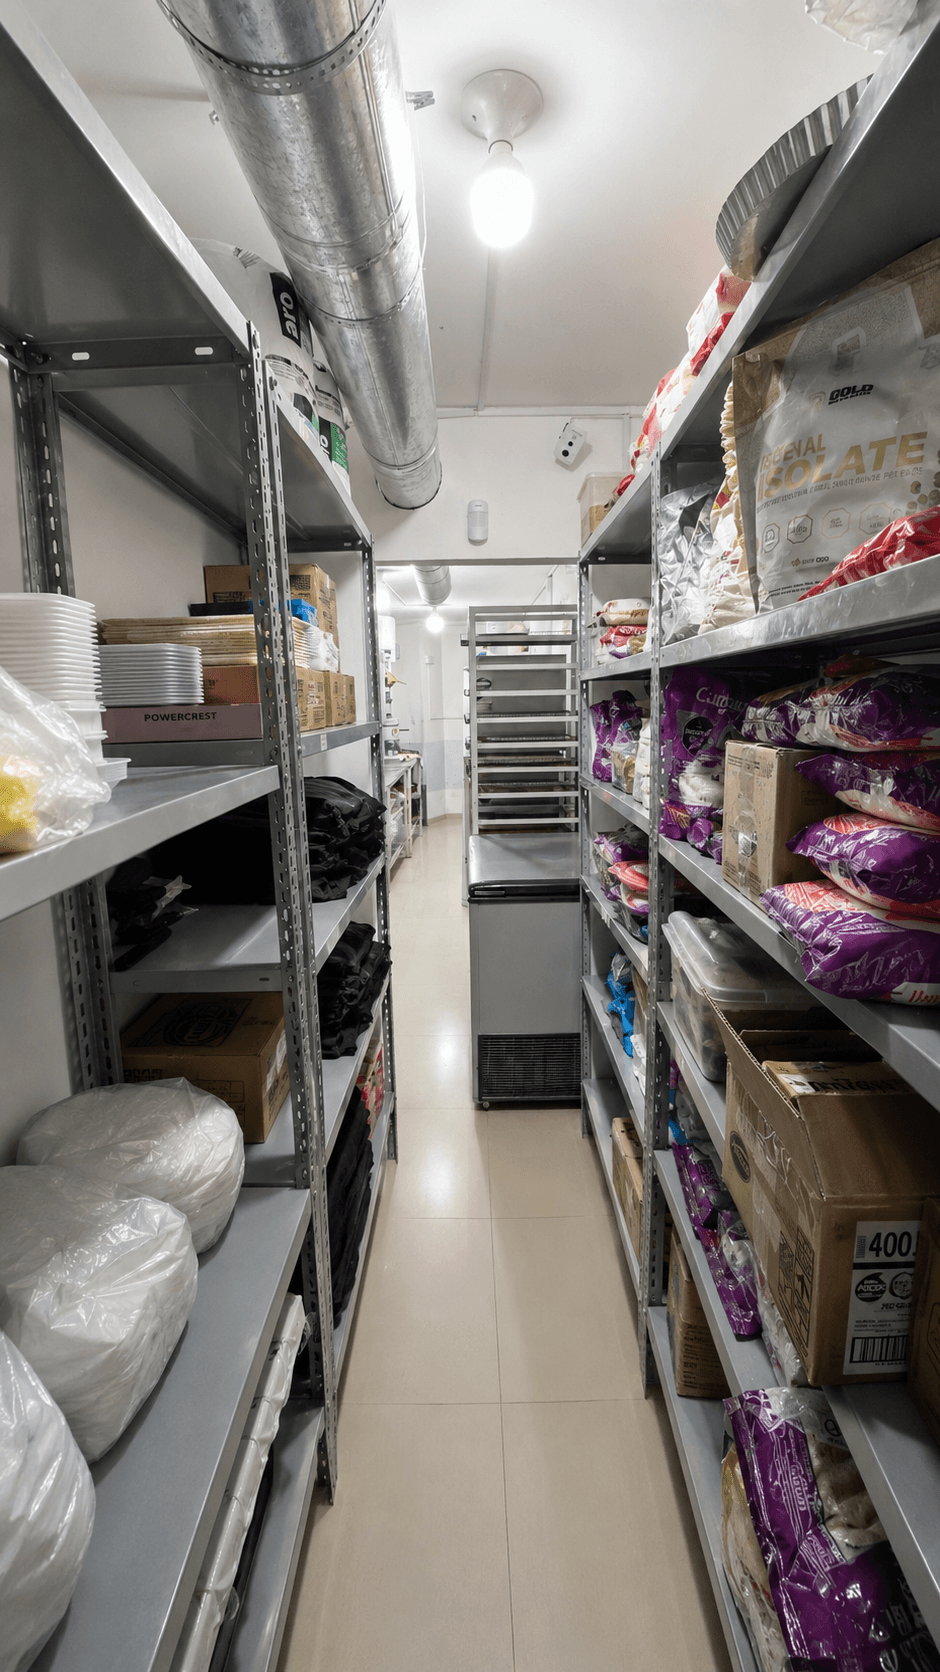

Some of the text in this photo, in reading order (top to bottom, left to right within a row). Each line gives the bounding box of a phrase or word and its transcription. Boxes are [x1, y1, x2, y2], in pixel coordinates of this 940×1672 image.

[280, 291, 299, 340] aro
[757, 431, 928, 502] ISOLATE
[143, 711, 218, 722] POWERCREST
